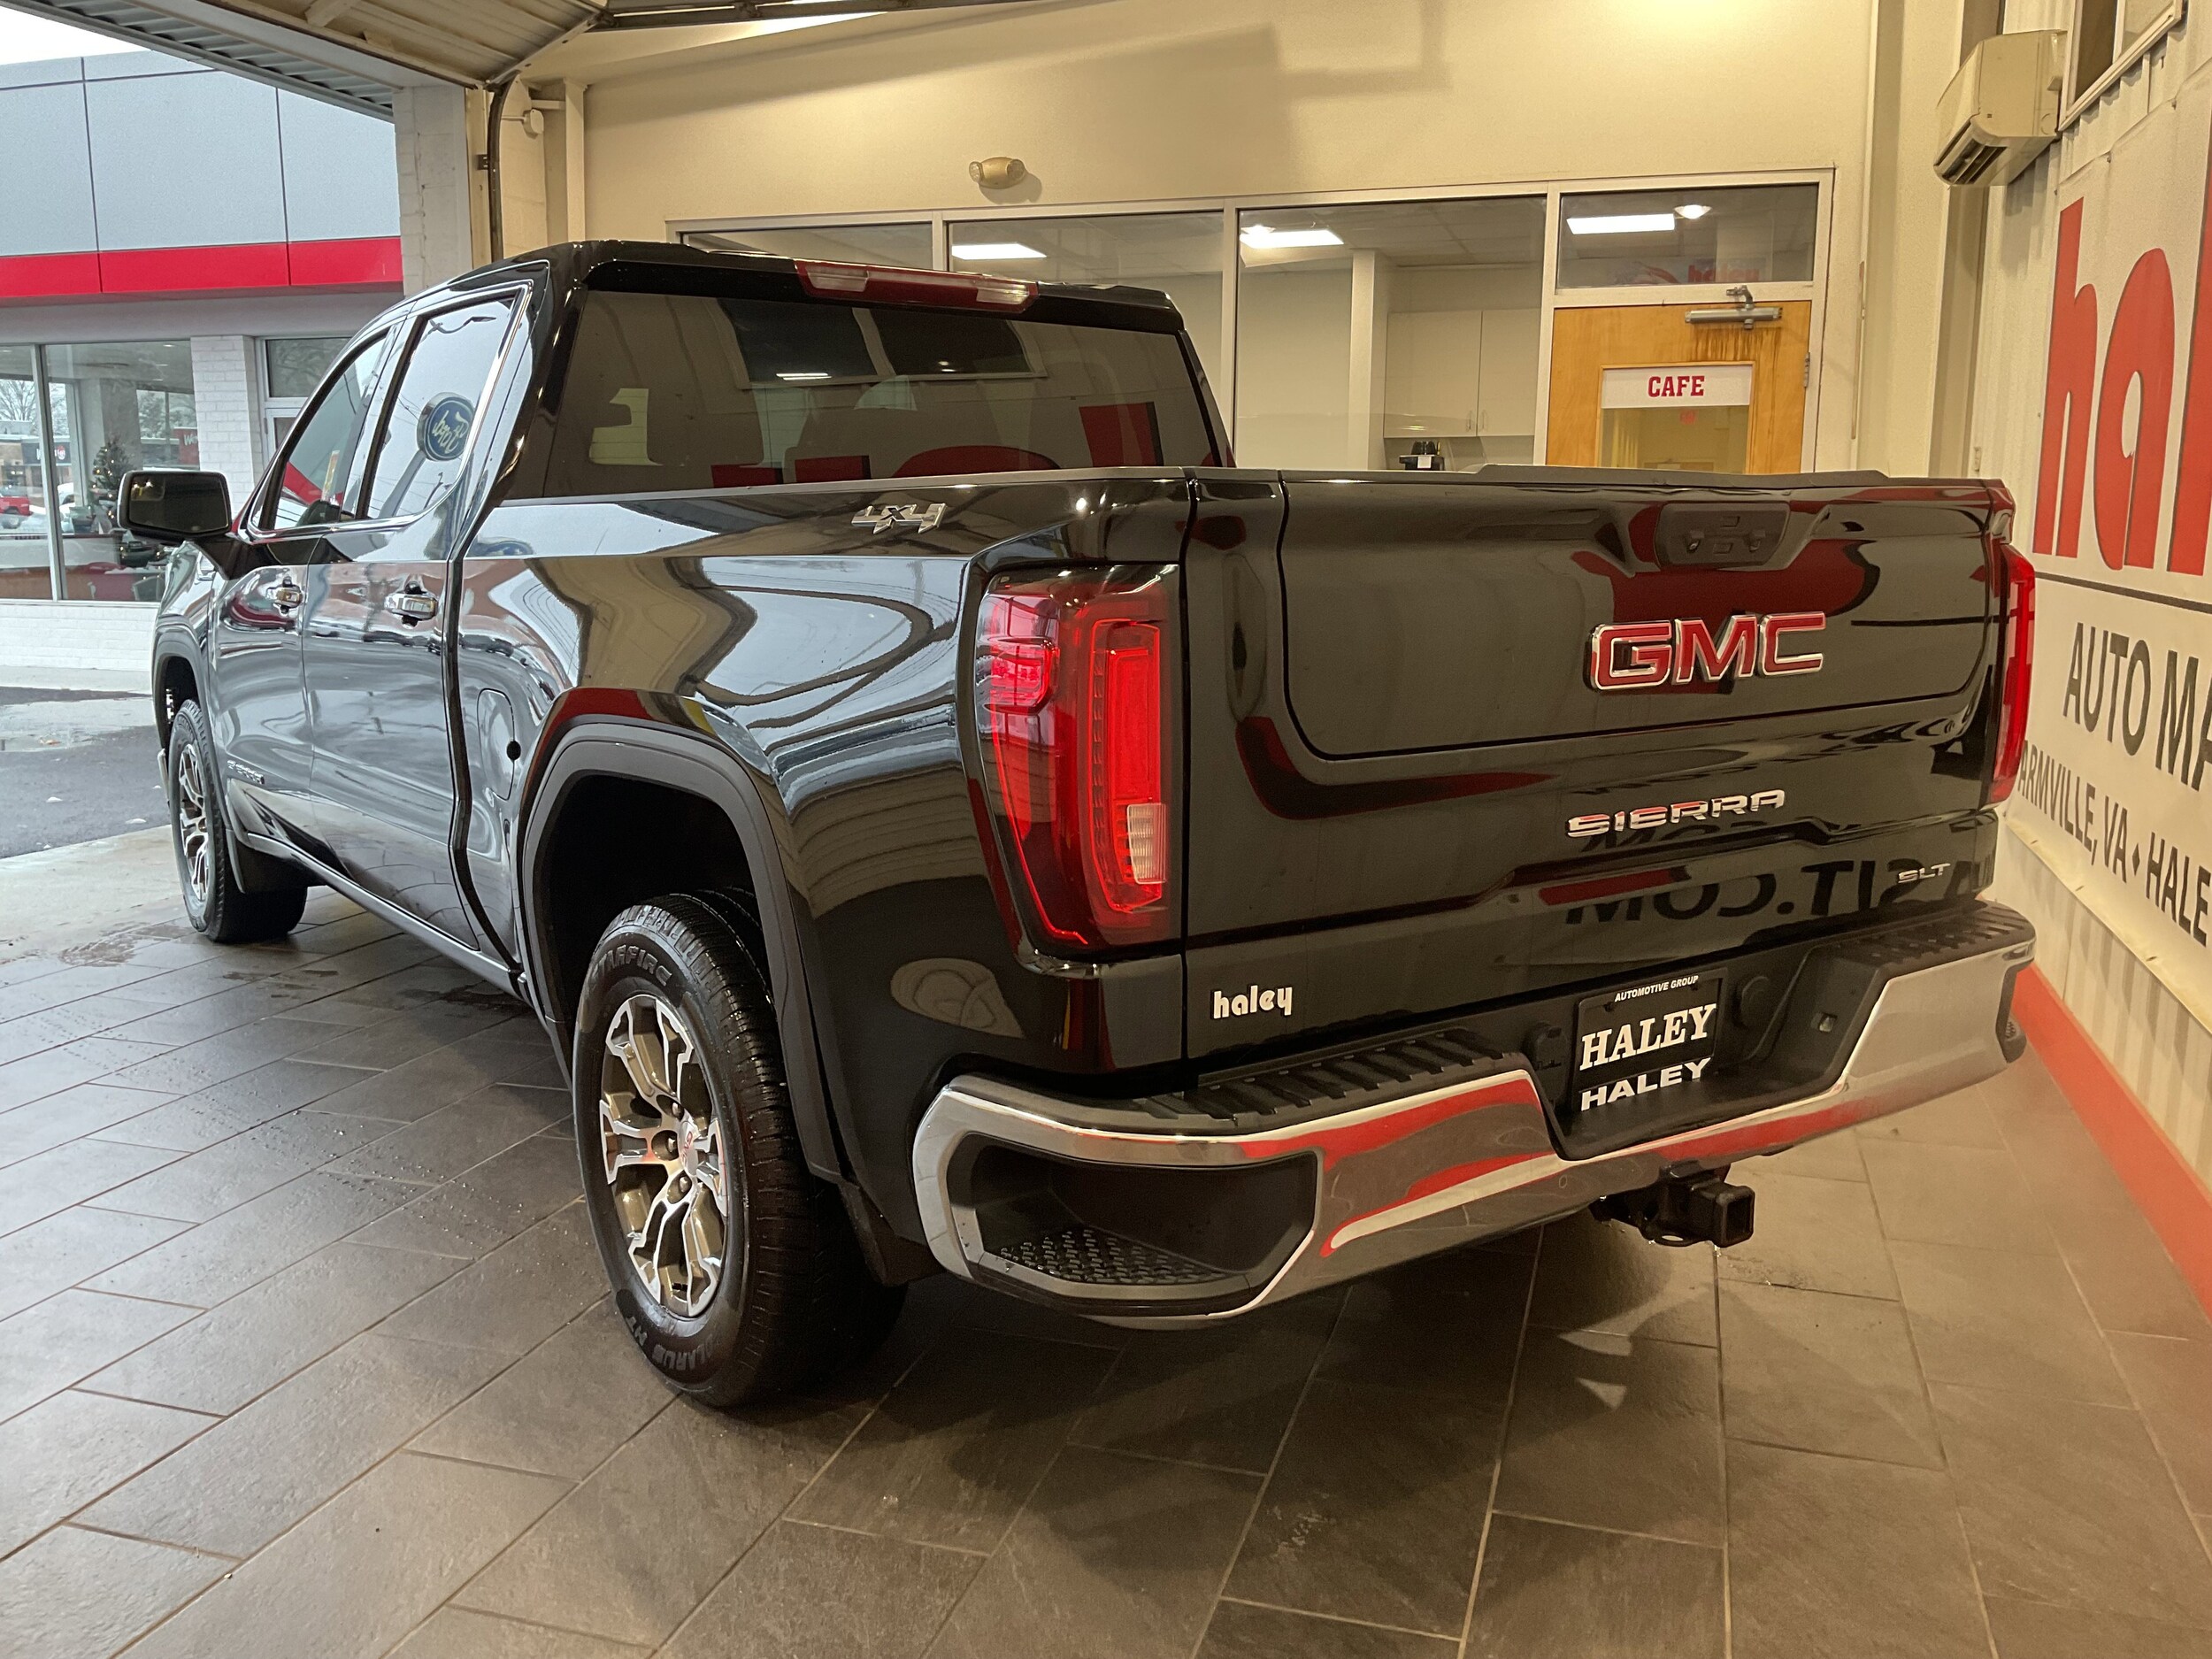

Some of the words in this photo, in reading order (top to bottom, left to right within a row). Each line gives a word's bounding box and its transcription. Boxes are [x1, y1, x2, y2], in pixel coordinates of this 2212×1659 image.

[1648, 375, 1705, 397] CAFE
[1590, 611, 1826, 691] GMC
[2062, 622, 2151, 756] AUTO
[1567, 789, 1786, 837] SIERRA
[2017, 740, 2098, 865] ARMVILLE,
[2104, 795, 2128, 883] VA
[1898, 863, 1951, 884] SLT
[1213, 985, 1293, 1019] haley
[1615, 982, 1669, 1002] AUTOMOTIVE
[1671, 975, 1699, 988] GROUP
[1579, 1003, 1717, 1071] HALEY
[1581, 1057, 1711, 1111] HALEY
